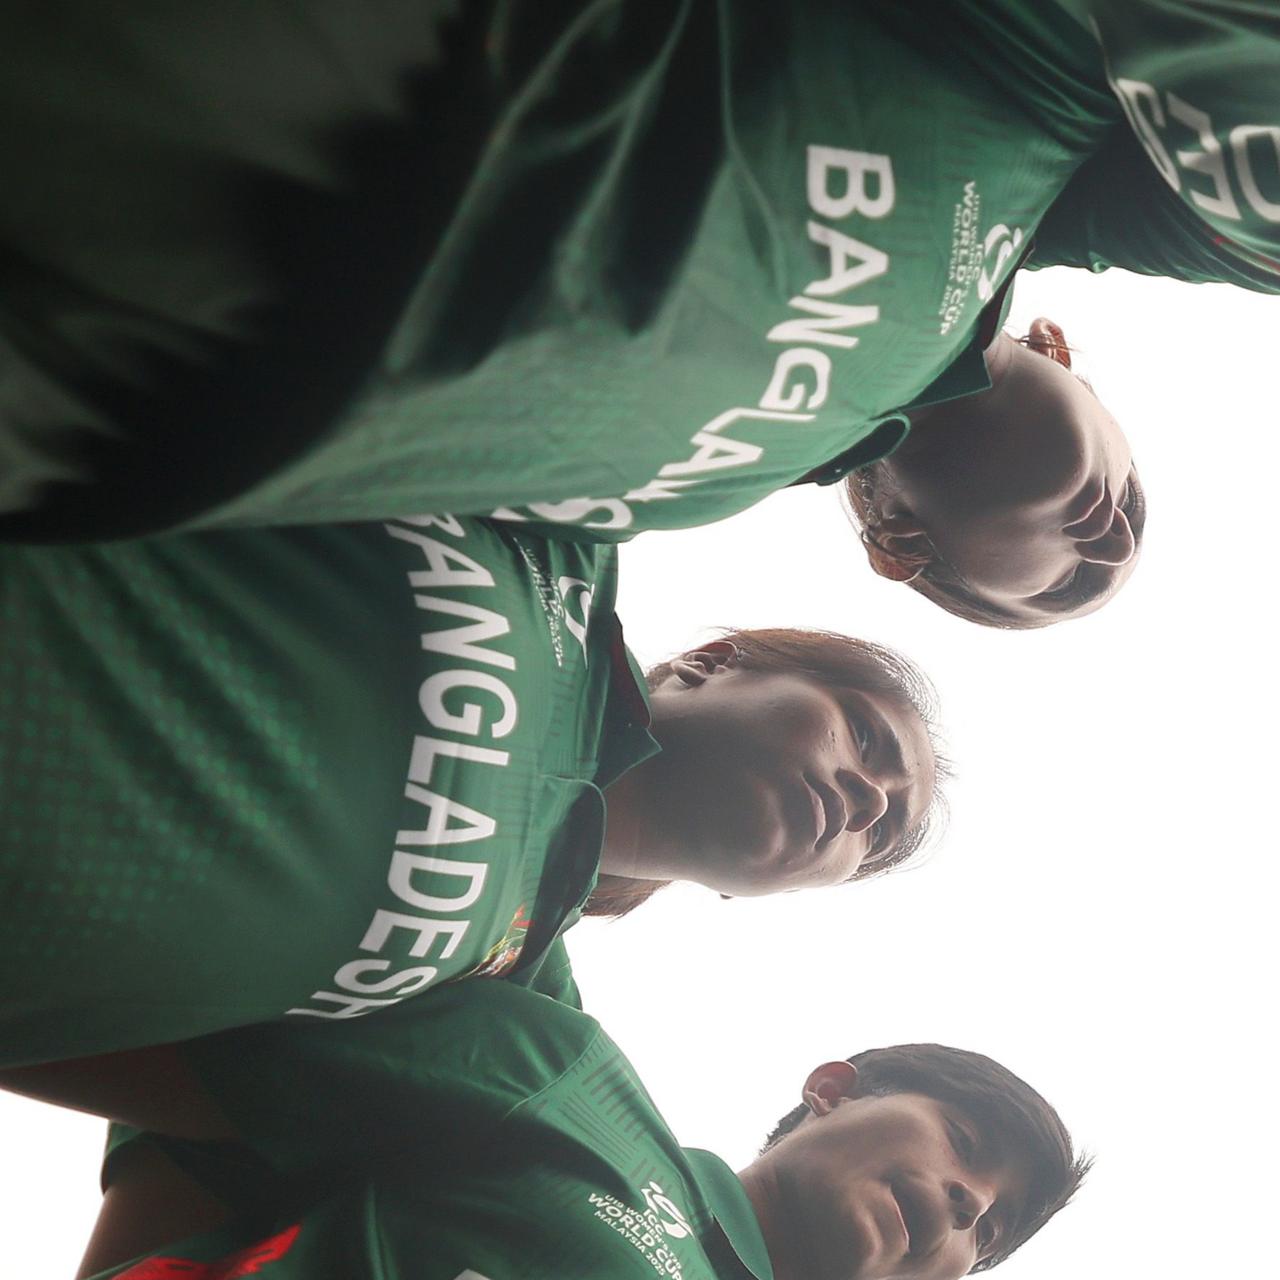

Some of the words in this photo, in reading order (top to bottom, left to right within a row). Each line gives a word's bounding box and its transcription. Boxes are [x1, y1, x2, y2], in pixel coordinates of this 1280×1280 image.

[955, 181, 976, 283] WORLD
[940, 288, 962, 336] CUP
[588, 1193, 656, 1247] WORLD
[594, 1210, 647, 1254] MALAYSIA
[645, 1252, 666, 1276] 2025
[604, 1194, 625, 1209] U19
[625, 1207, 669, 1251] WOMEN'S
[643, 1208, 665, 1236] ICC
